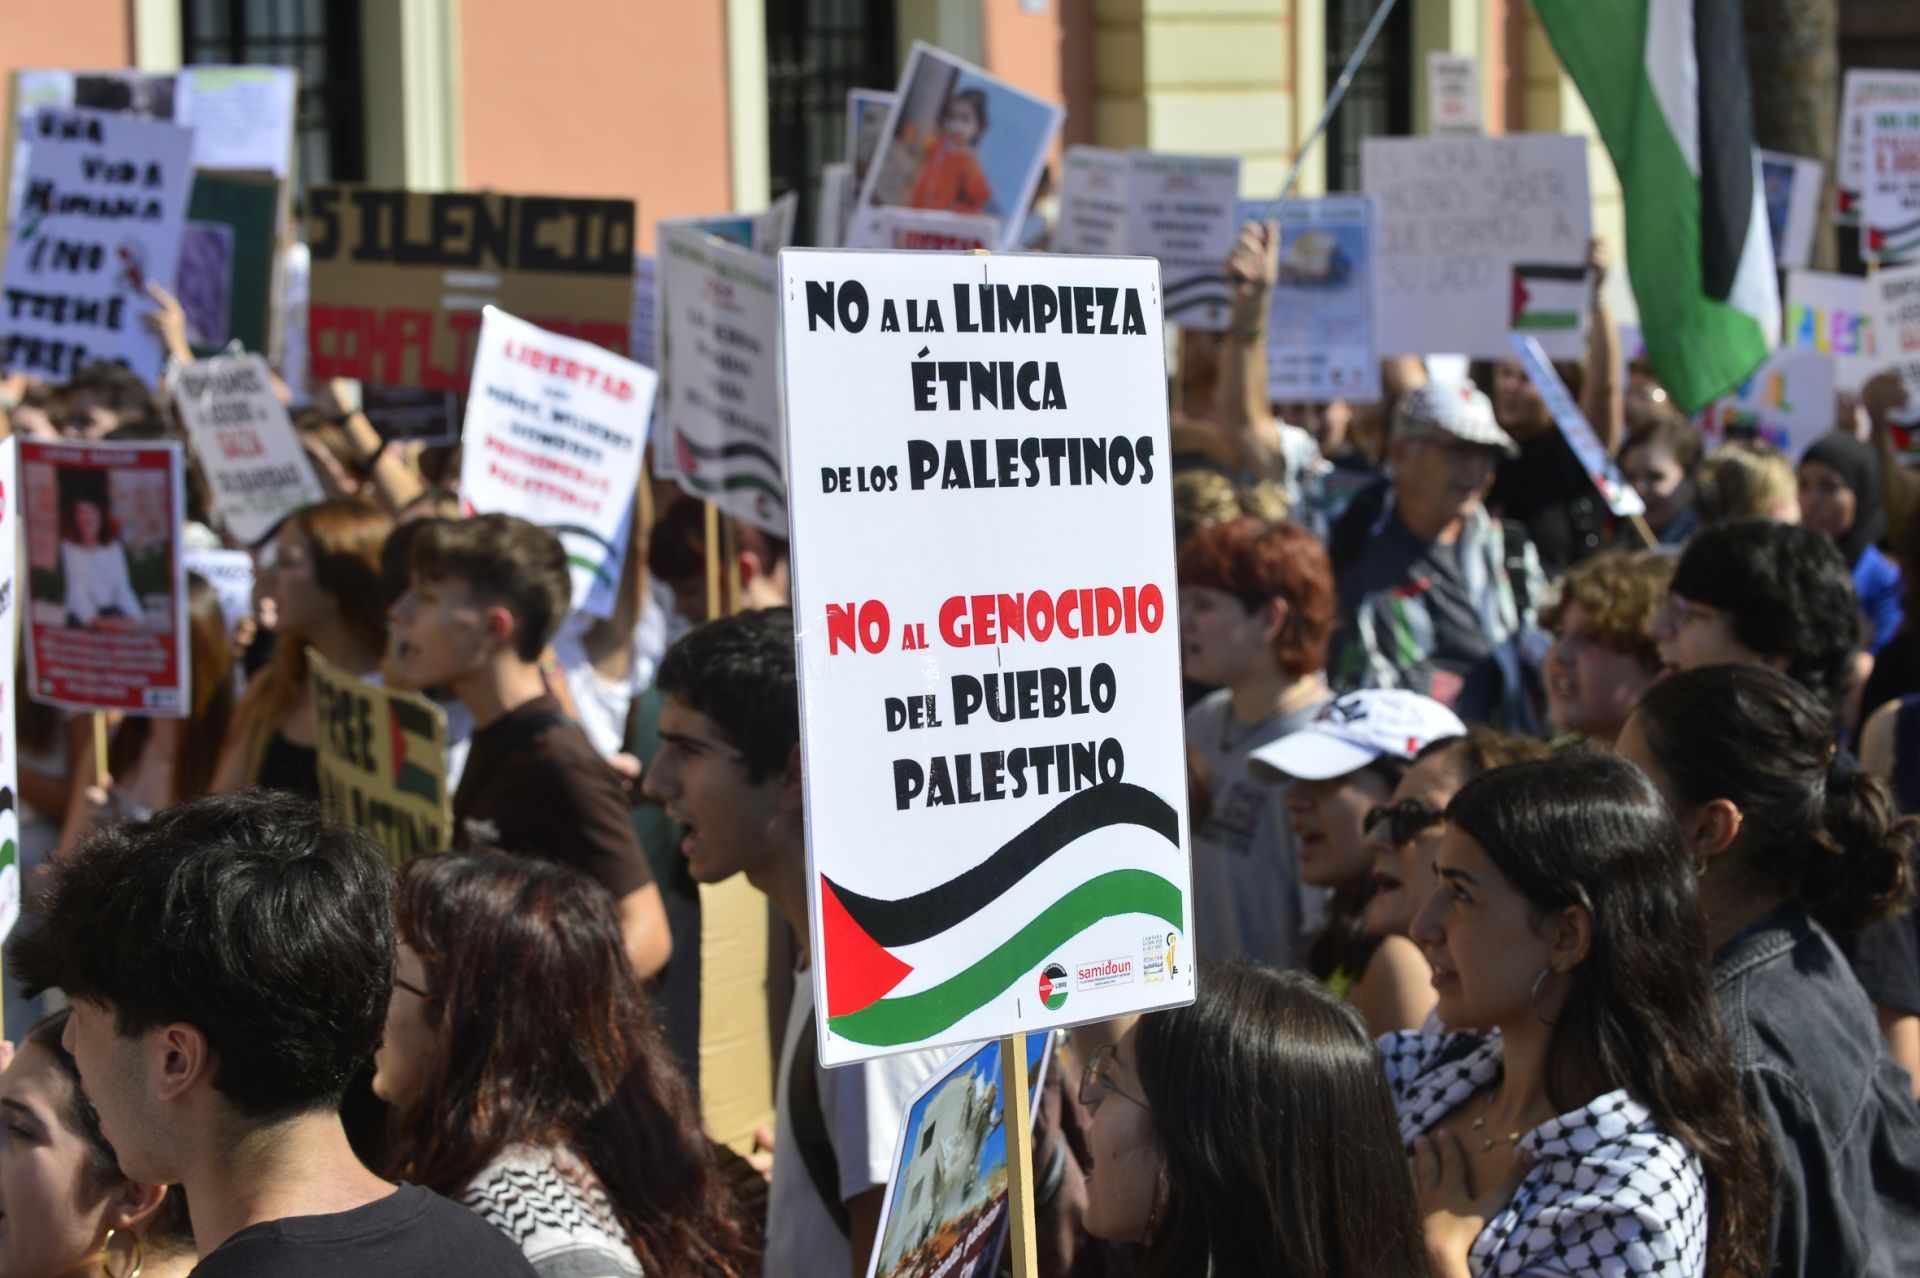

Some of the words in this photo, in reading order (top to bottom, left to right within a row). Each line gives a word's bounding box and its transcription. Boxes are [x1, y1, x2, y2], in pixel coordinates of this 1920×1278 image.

[305, 187, 634, 275] SILENCIO
[806, 280, 869, 333] NO
[881, 299, 900, 333] A
[906, 300, 944, 333] LA
[953, 283, 1146, 335] LIMPIEZA
[504, 338, 636, 402] LIBERTAD
[911, 345, 1067, 411] ÉTNICA
[821, 467, 851, 493] DE
[857, 466, 898, 492] LOS
[908, 435, 1154, 490] PALESTINOS
[826, 600, 890, 656] NO
[901, 623, 929, 650] AL
[938, 583, 1164, 647] GENOCIDIO
[885, 694, 942, 732] DEL
[951, 662, 1117, 726] PUEBLO
[893, 737, 1124, 811] PALESTINO
[1079, 960, 1131, 980] samidoun
